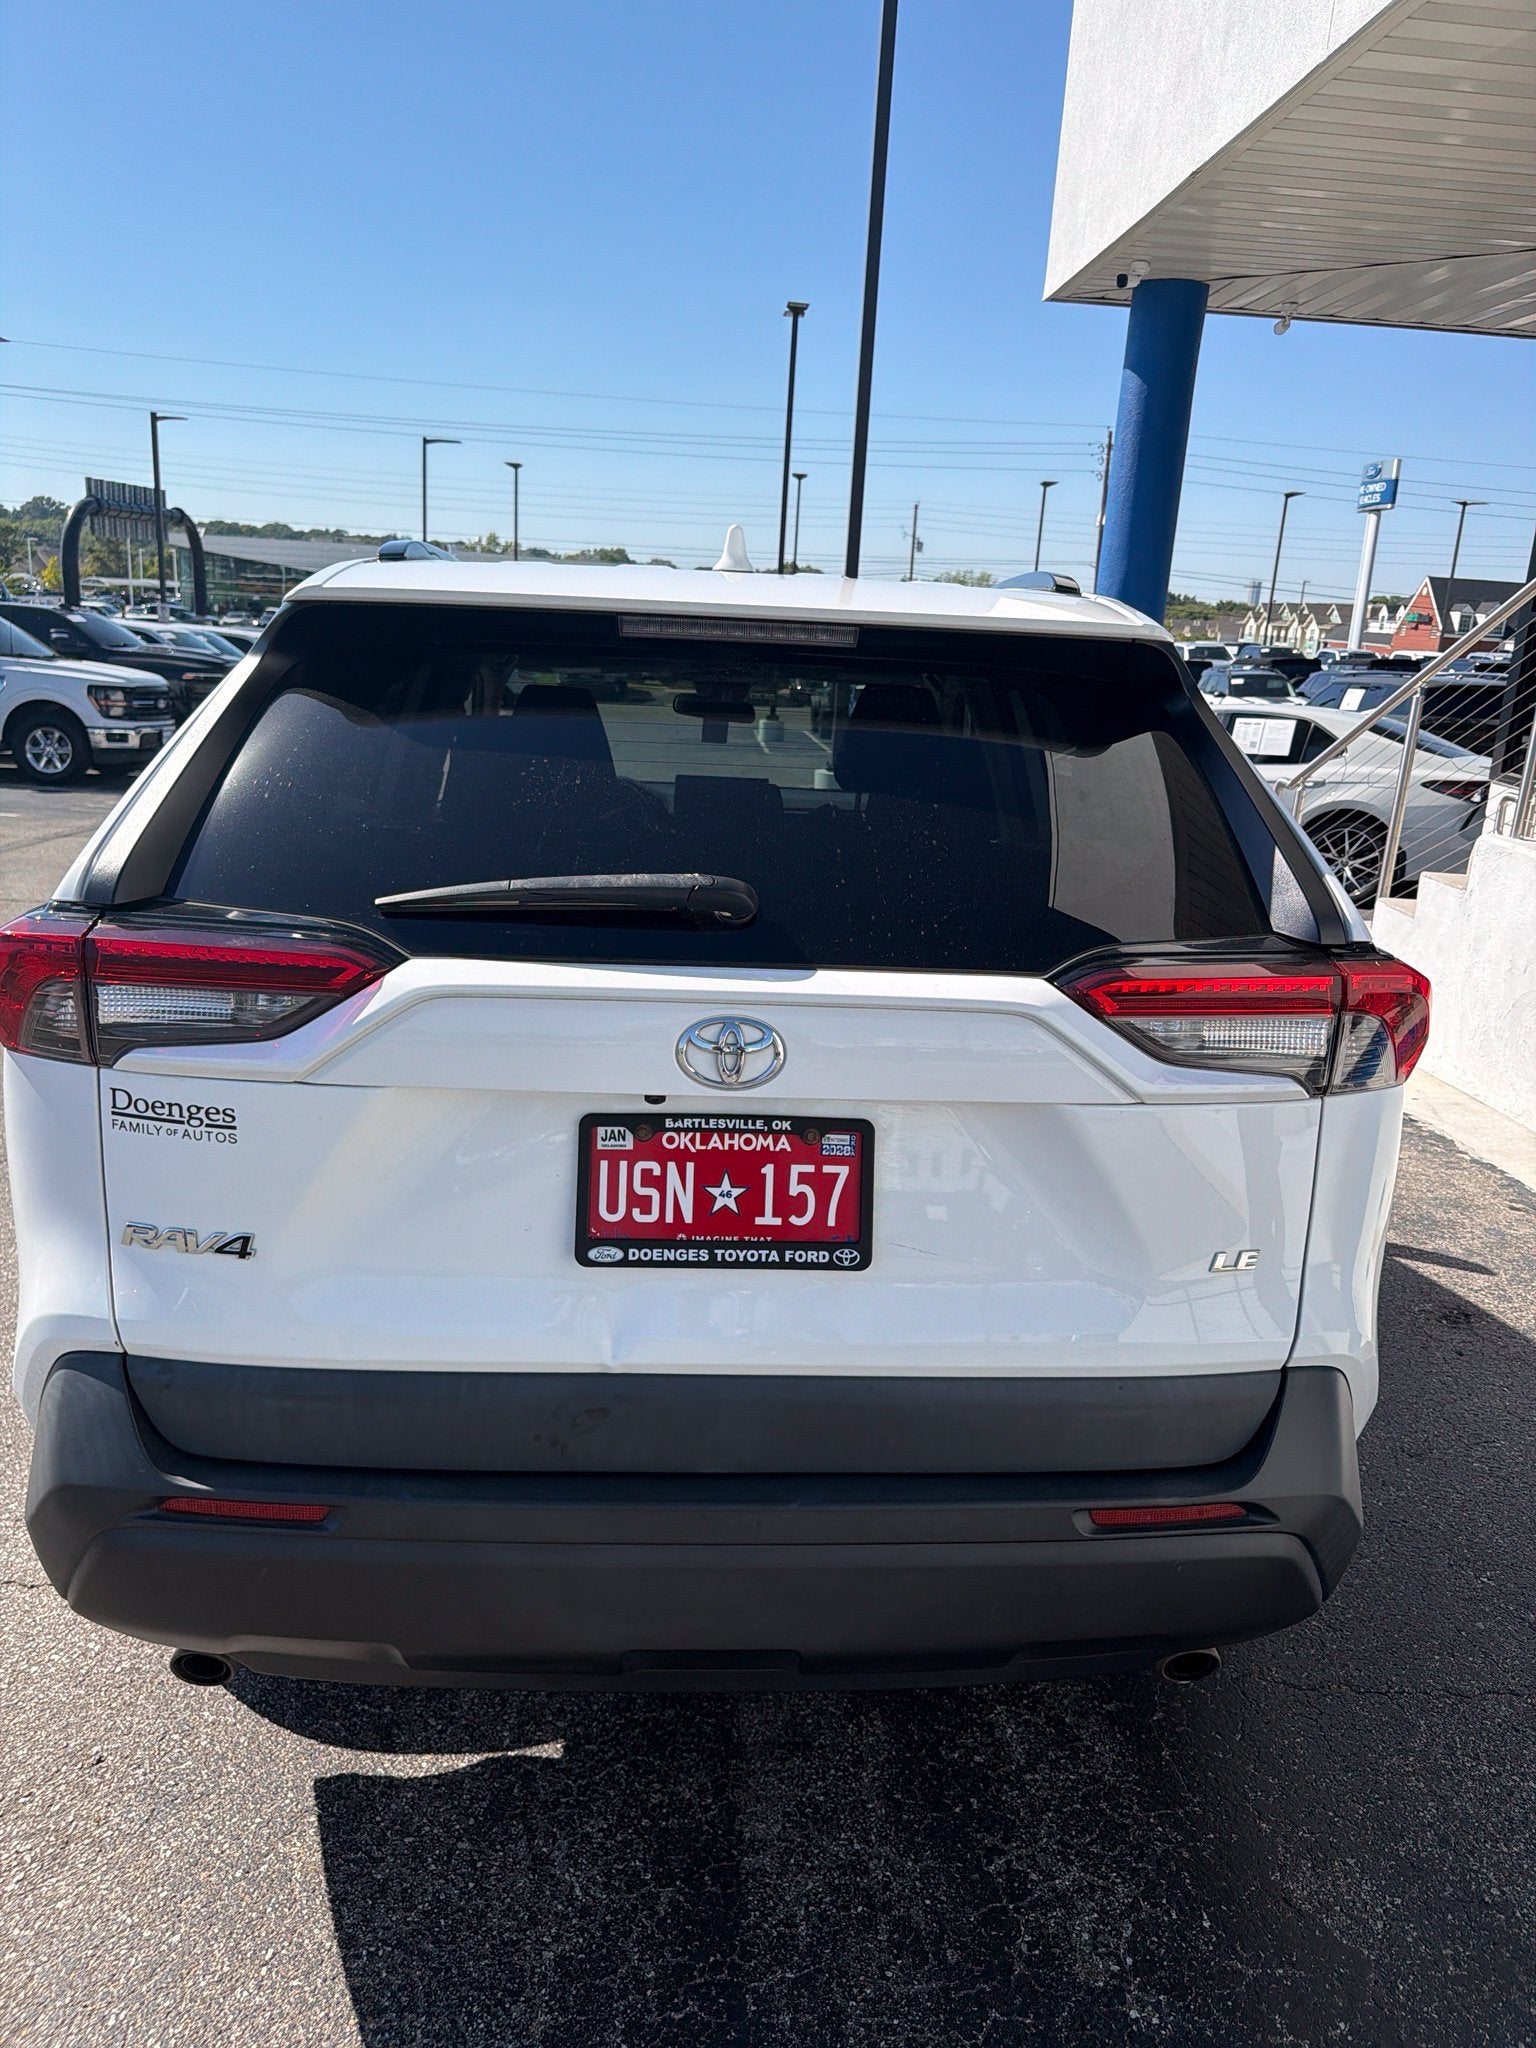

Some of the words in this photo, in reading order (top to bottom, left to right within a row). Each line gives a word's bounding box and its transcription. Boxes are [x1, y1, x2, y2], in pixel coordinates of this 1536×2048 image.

[110, 1087, 237, 1128] Doenges
[111, 1118, 163, 1136] FAMILY
[165, 1128, 179, 1136] OF
[181, 1128, 238, 1144] AUTOS
[665, 1118, 768, 1132] BARTLESVILLE,
[775, 1120, 792, 1131] OK
[601, 1129, 626, 1142] JAN
[662, 1132, 792, 1152] OKLAHOMA
[598, 1160, 695, 1224] USN
[754, 1163, 850, 1226] 157
[718, 1190, 732, 1199] 46
[121, 1221, 257, 1260] RAV4
[594, 1249, 617, 1260] Ford
[628, 1248, 710, 1261] DOENGES
[714, 1249, 779, 1262] TOYOTA
[785, 1251, 830, 1263] FORD
[1208, 1249, 1261, 1273] LE
